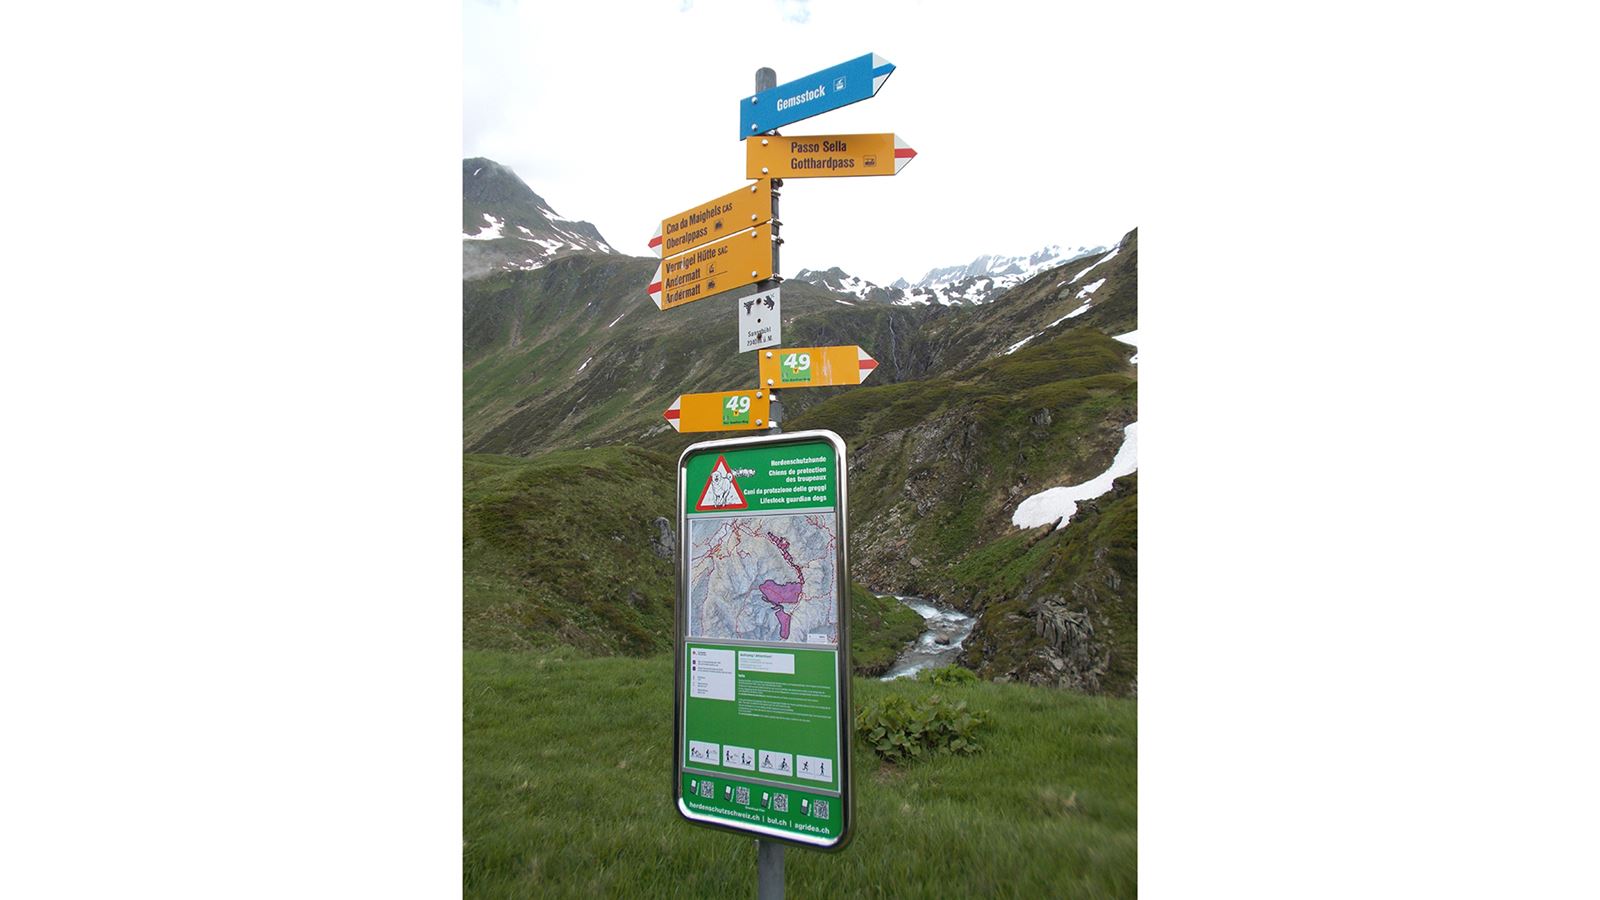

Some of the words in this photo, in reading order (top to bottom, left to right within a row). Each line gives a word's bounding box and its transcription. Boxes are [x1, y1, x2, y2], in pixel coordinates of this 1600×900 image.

[777, 85, 826, 111] Gemsstock
[791, 141, 819, 153] Passo
[823, 140, 847, 152] Sella
[791, 157, 855, 170] Gotthardpass
[667, 223, 679, 234] Cna
[680, 218, 688, 230] da
[689, 205, 722, 226] Maighels
[722, 202, 733, 212] CAS
[666, 227, 708, 250] Oberalppass
[665, 253, 696, 274] Vermigel
[696, 248, 717, 263] Hütte
[717, 246, 728, 256] SAC
[665, 268, 701, 289] Andermatt
[666, 285, 701, 303] Andermatt
[784, 353, 811, 370] 49
[726, 395, 751, 413] 49
[771, 456, 827, 466] Herdenschutzhunde
[796, 467, 827, 475] protection
[763, 487, 792, 495] protezione
[807, 484, 827, 492] greggi
[689, 801, 760, 821] herdenschutzschweiz.ch
[767, 816, 787, 827] bul.ch
[794, 822, 830, 835] agridea.ch
